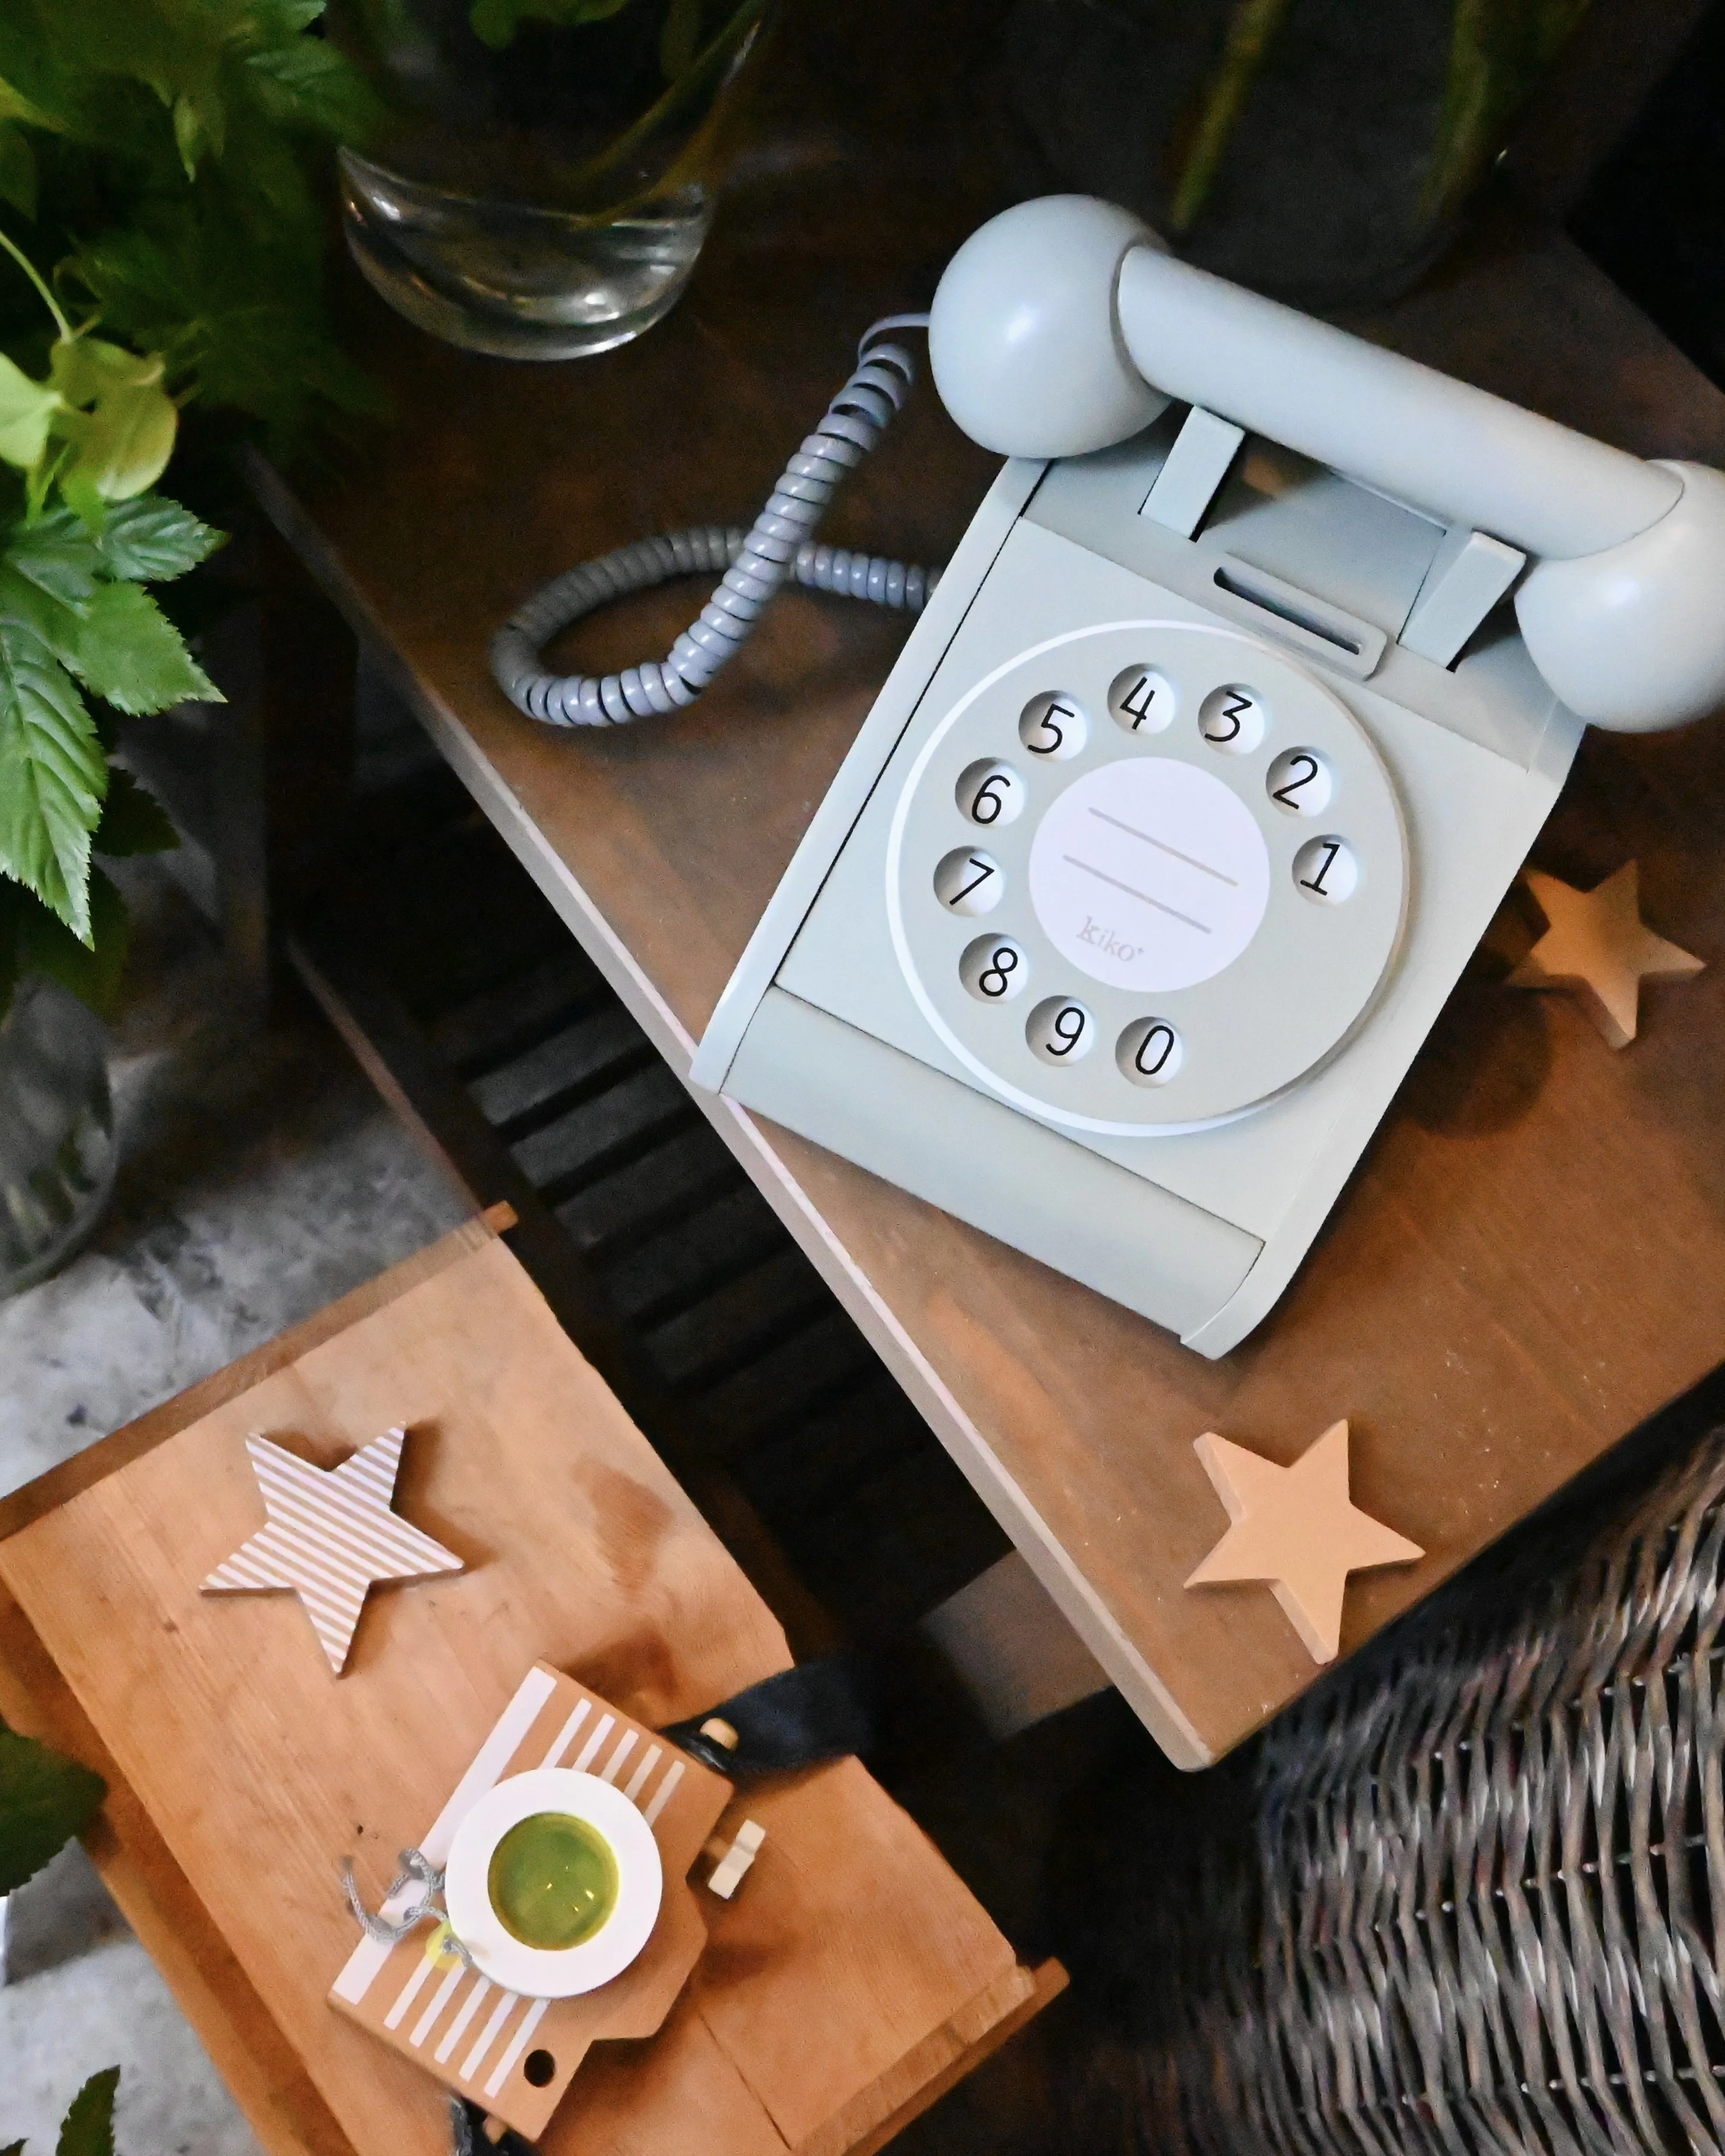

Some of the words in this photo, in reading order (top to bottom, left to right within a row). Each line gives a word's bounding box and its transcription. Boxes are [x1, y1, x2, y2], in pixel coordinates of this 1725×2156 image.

[1027, 703, 1075, 754] 5
[1119, 677, 1155, 730] 4
[1204, 691, 1253, 742] 3
[971, 775, 1011, 825] 6
[1272, 754, 1318, 810] 2
[949, 858, 995, 906] 7
[1300, 842, 1341, 896] 1
[979, 947, 1018, 997] 8
[1045, 1007, 1085, 1056] 9
[1135, 1025, 1174, 1075] 0
